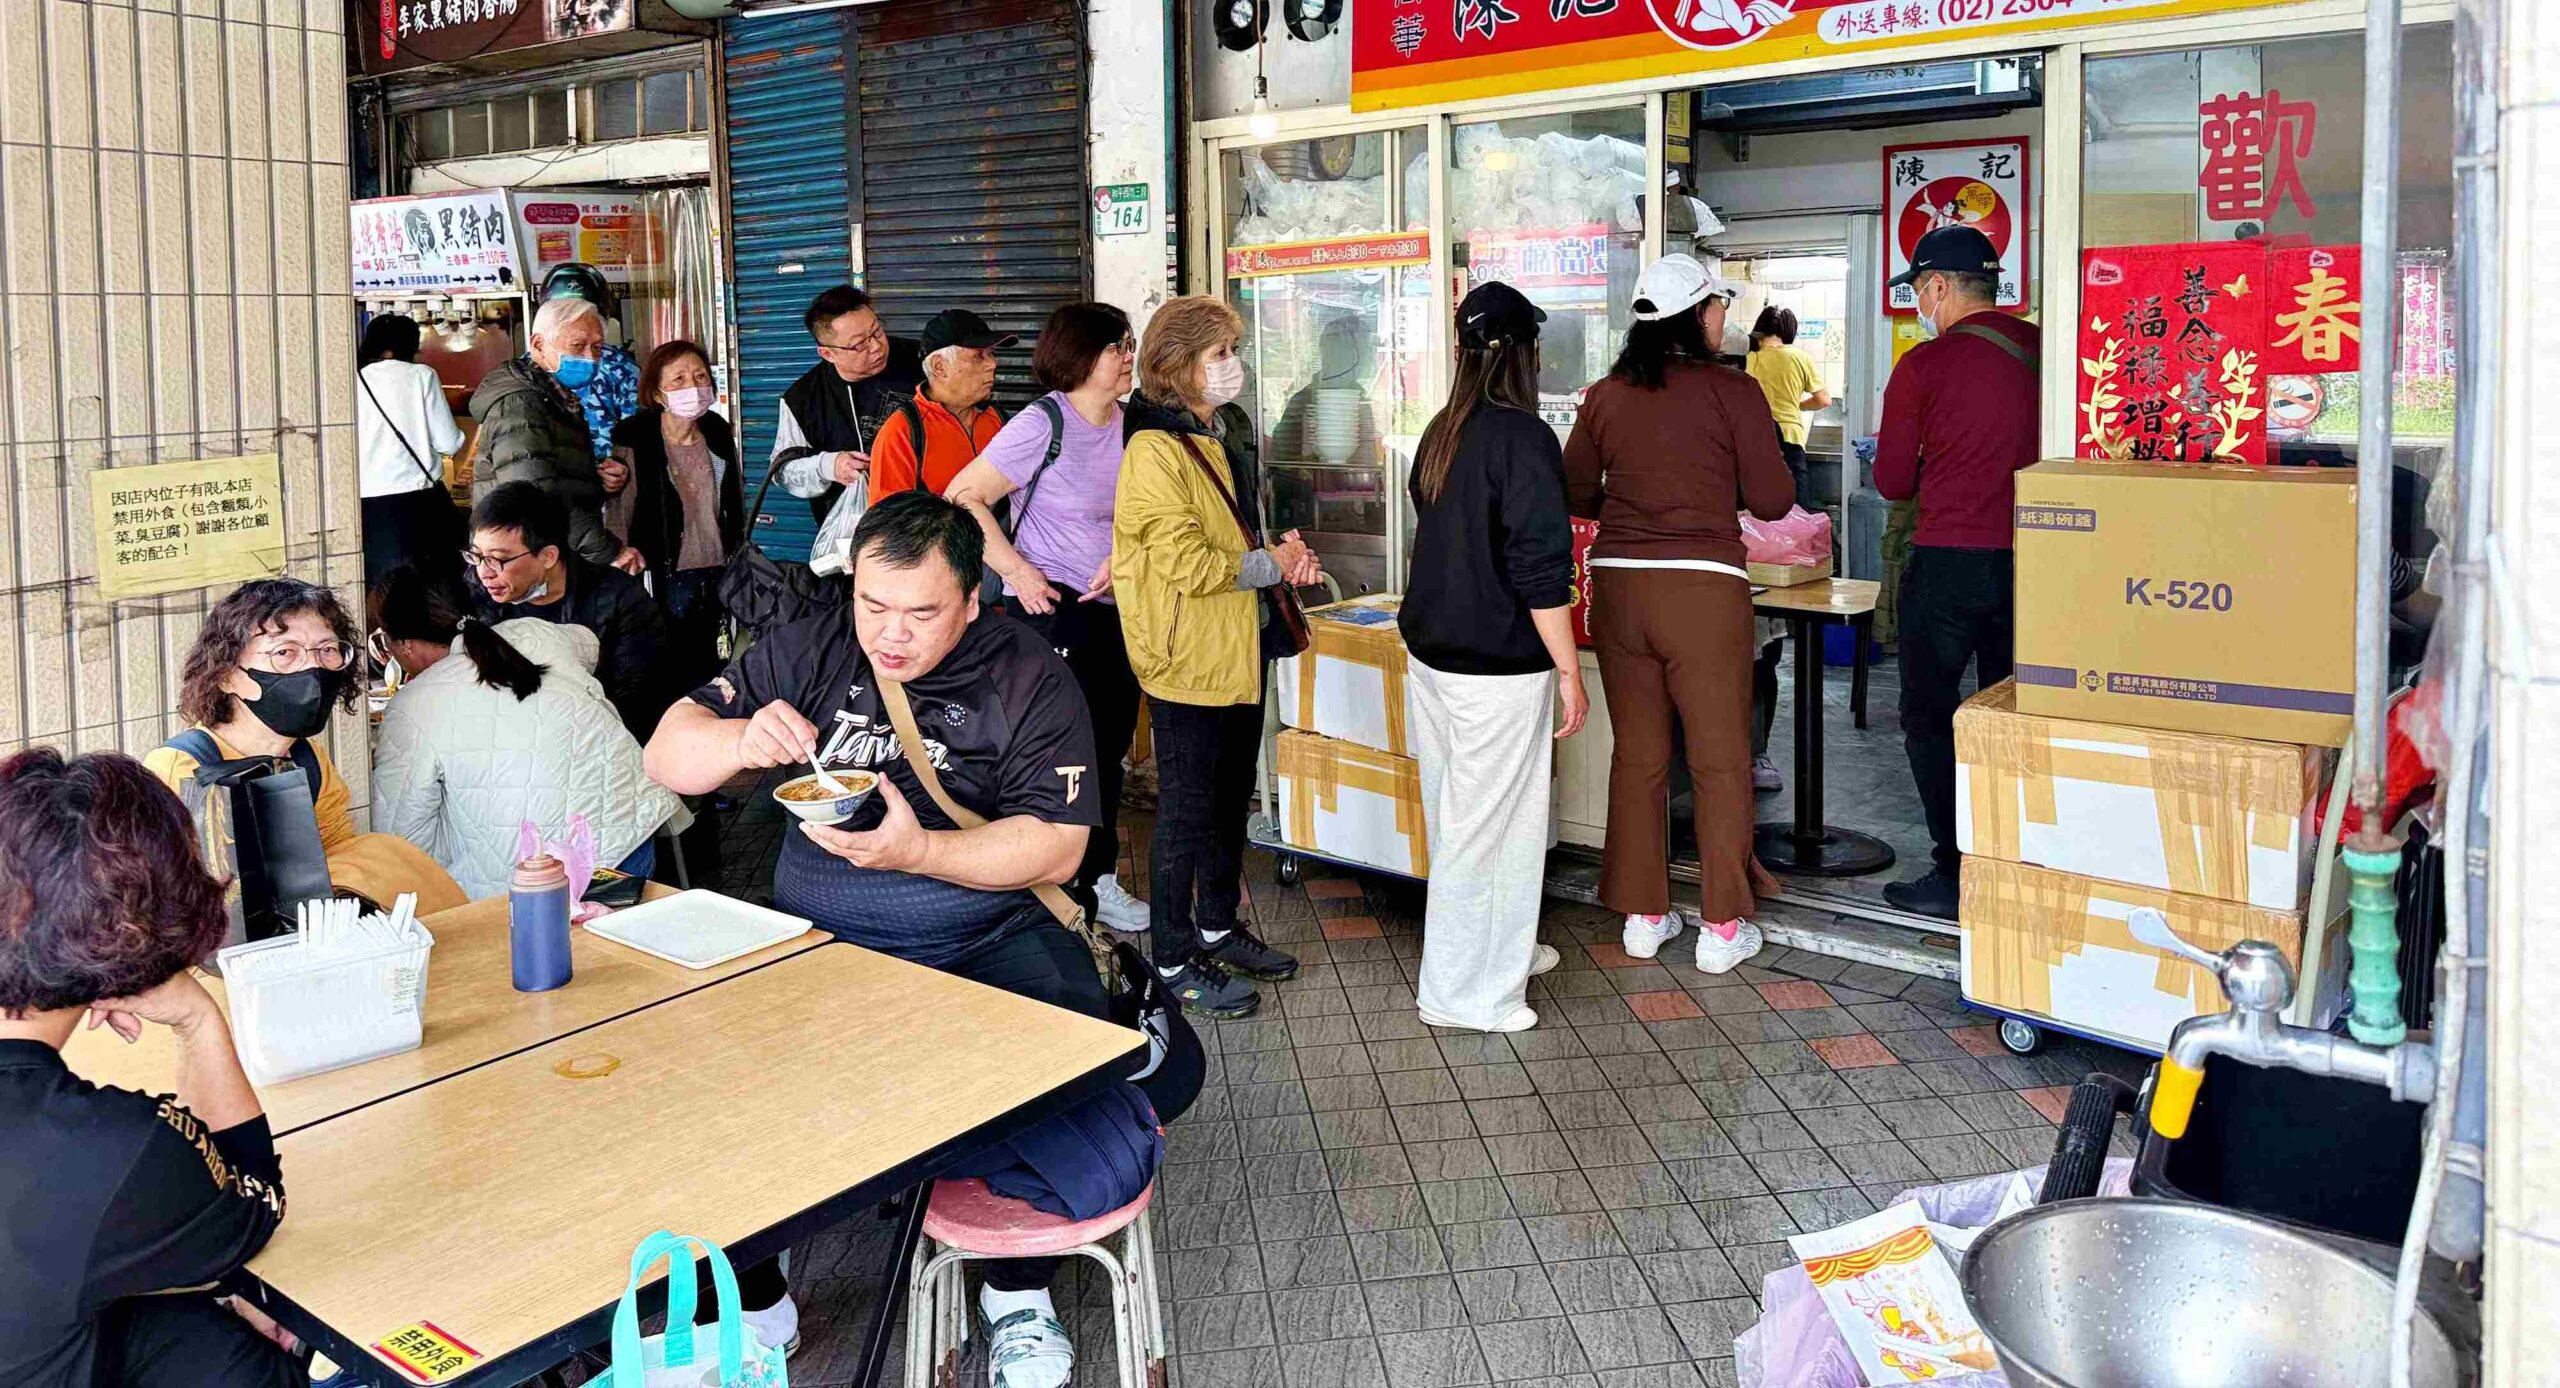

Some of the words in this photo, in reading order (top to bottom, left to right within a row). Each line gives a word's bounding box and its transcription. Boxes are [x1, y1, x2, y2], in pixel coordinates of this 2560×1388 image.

[1391, 0, 1427, 57] 華
[1835, 9, 1930, 38] 外送專線:
[438, 204, 505, 249] 黑豬肉
[1113, 205, 1143, 228] 164
[2269, 267, 2361, 362] 春
[2125, 577, 2233, 612] K-520
[2112, 684, 2135, 693] KING
[2155, 688, 2175, 696] SEN
[387, 1329, 464, 1376] 禁用外食
